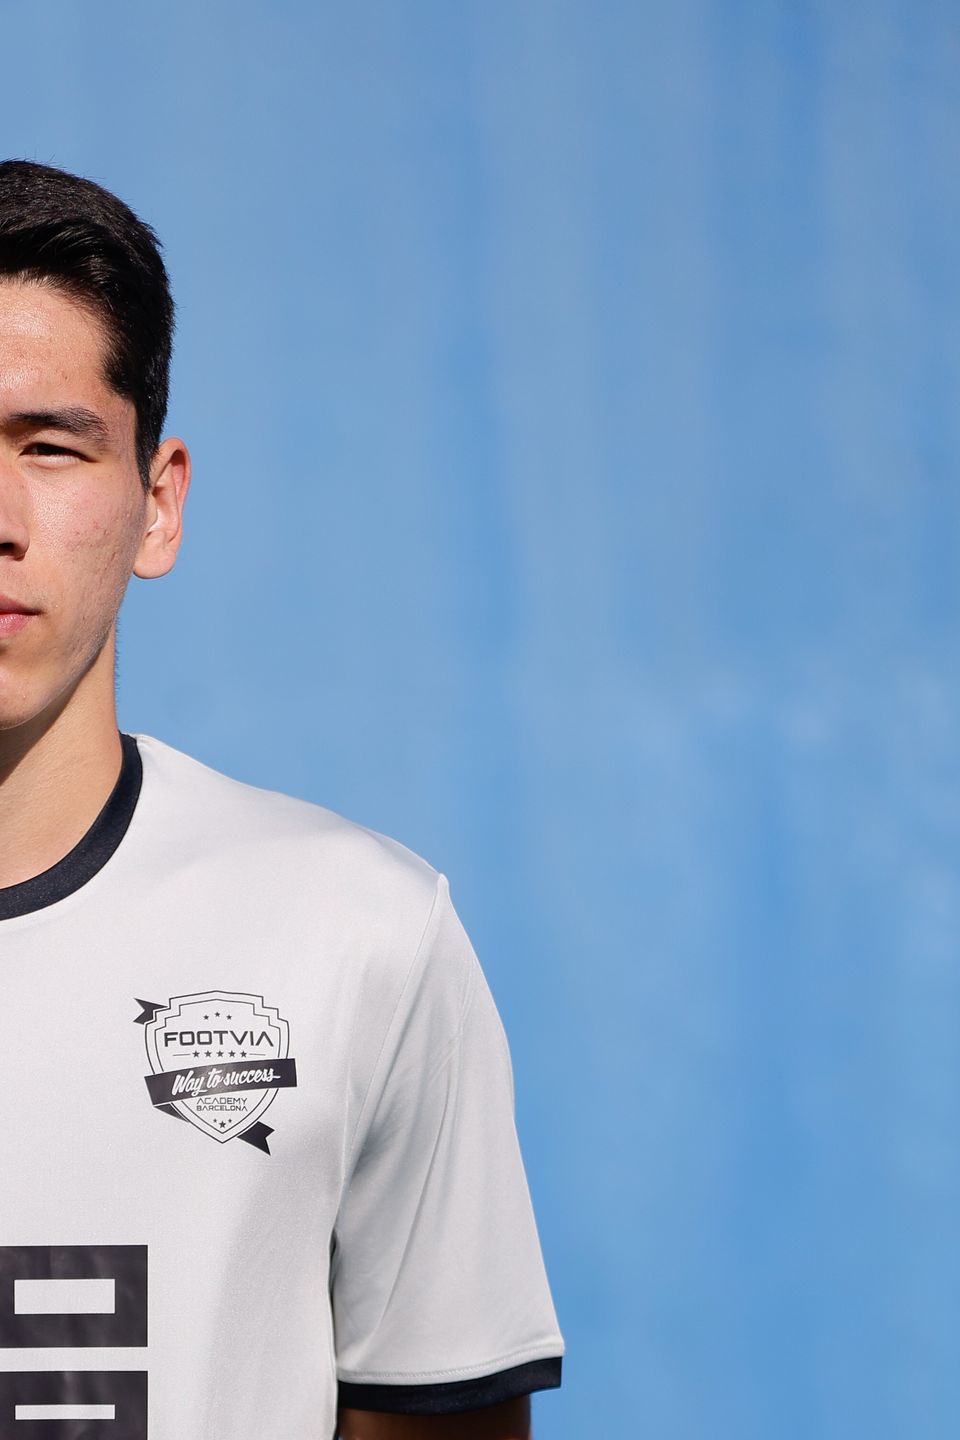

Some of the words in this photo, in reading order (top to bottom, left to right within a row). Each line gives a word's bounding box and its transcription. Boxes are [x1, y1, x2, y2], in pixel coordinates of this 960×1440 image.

[164, 1030, 274, 1047] FOOTVIA
[172, 1071, 207, 1096] Way
[206, 1068, 223, 1089] to
[224, 1068, 281, 1086] success
[196, 1097, 248, 1105] ACADEMY
